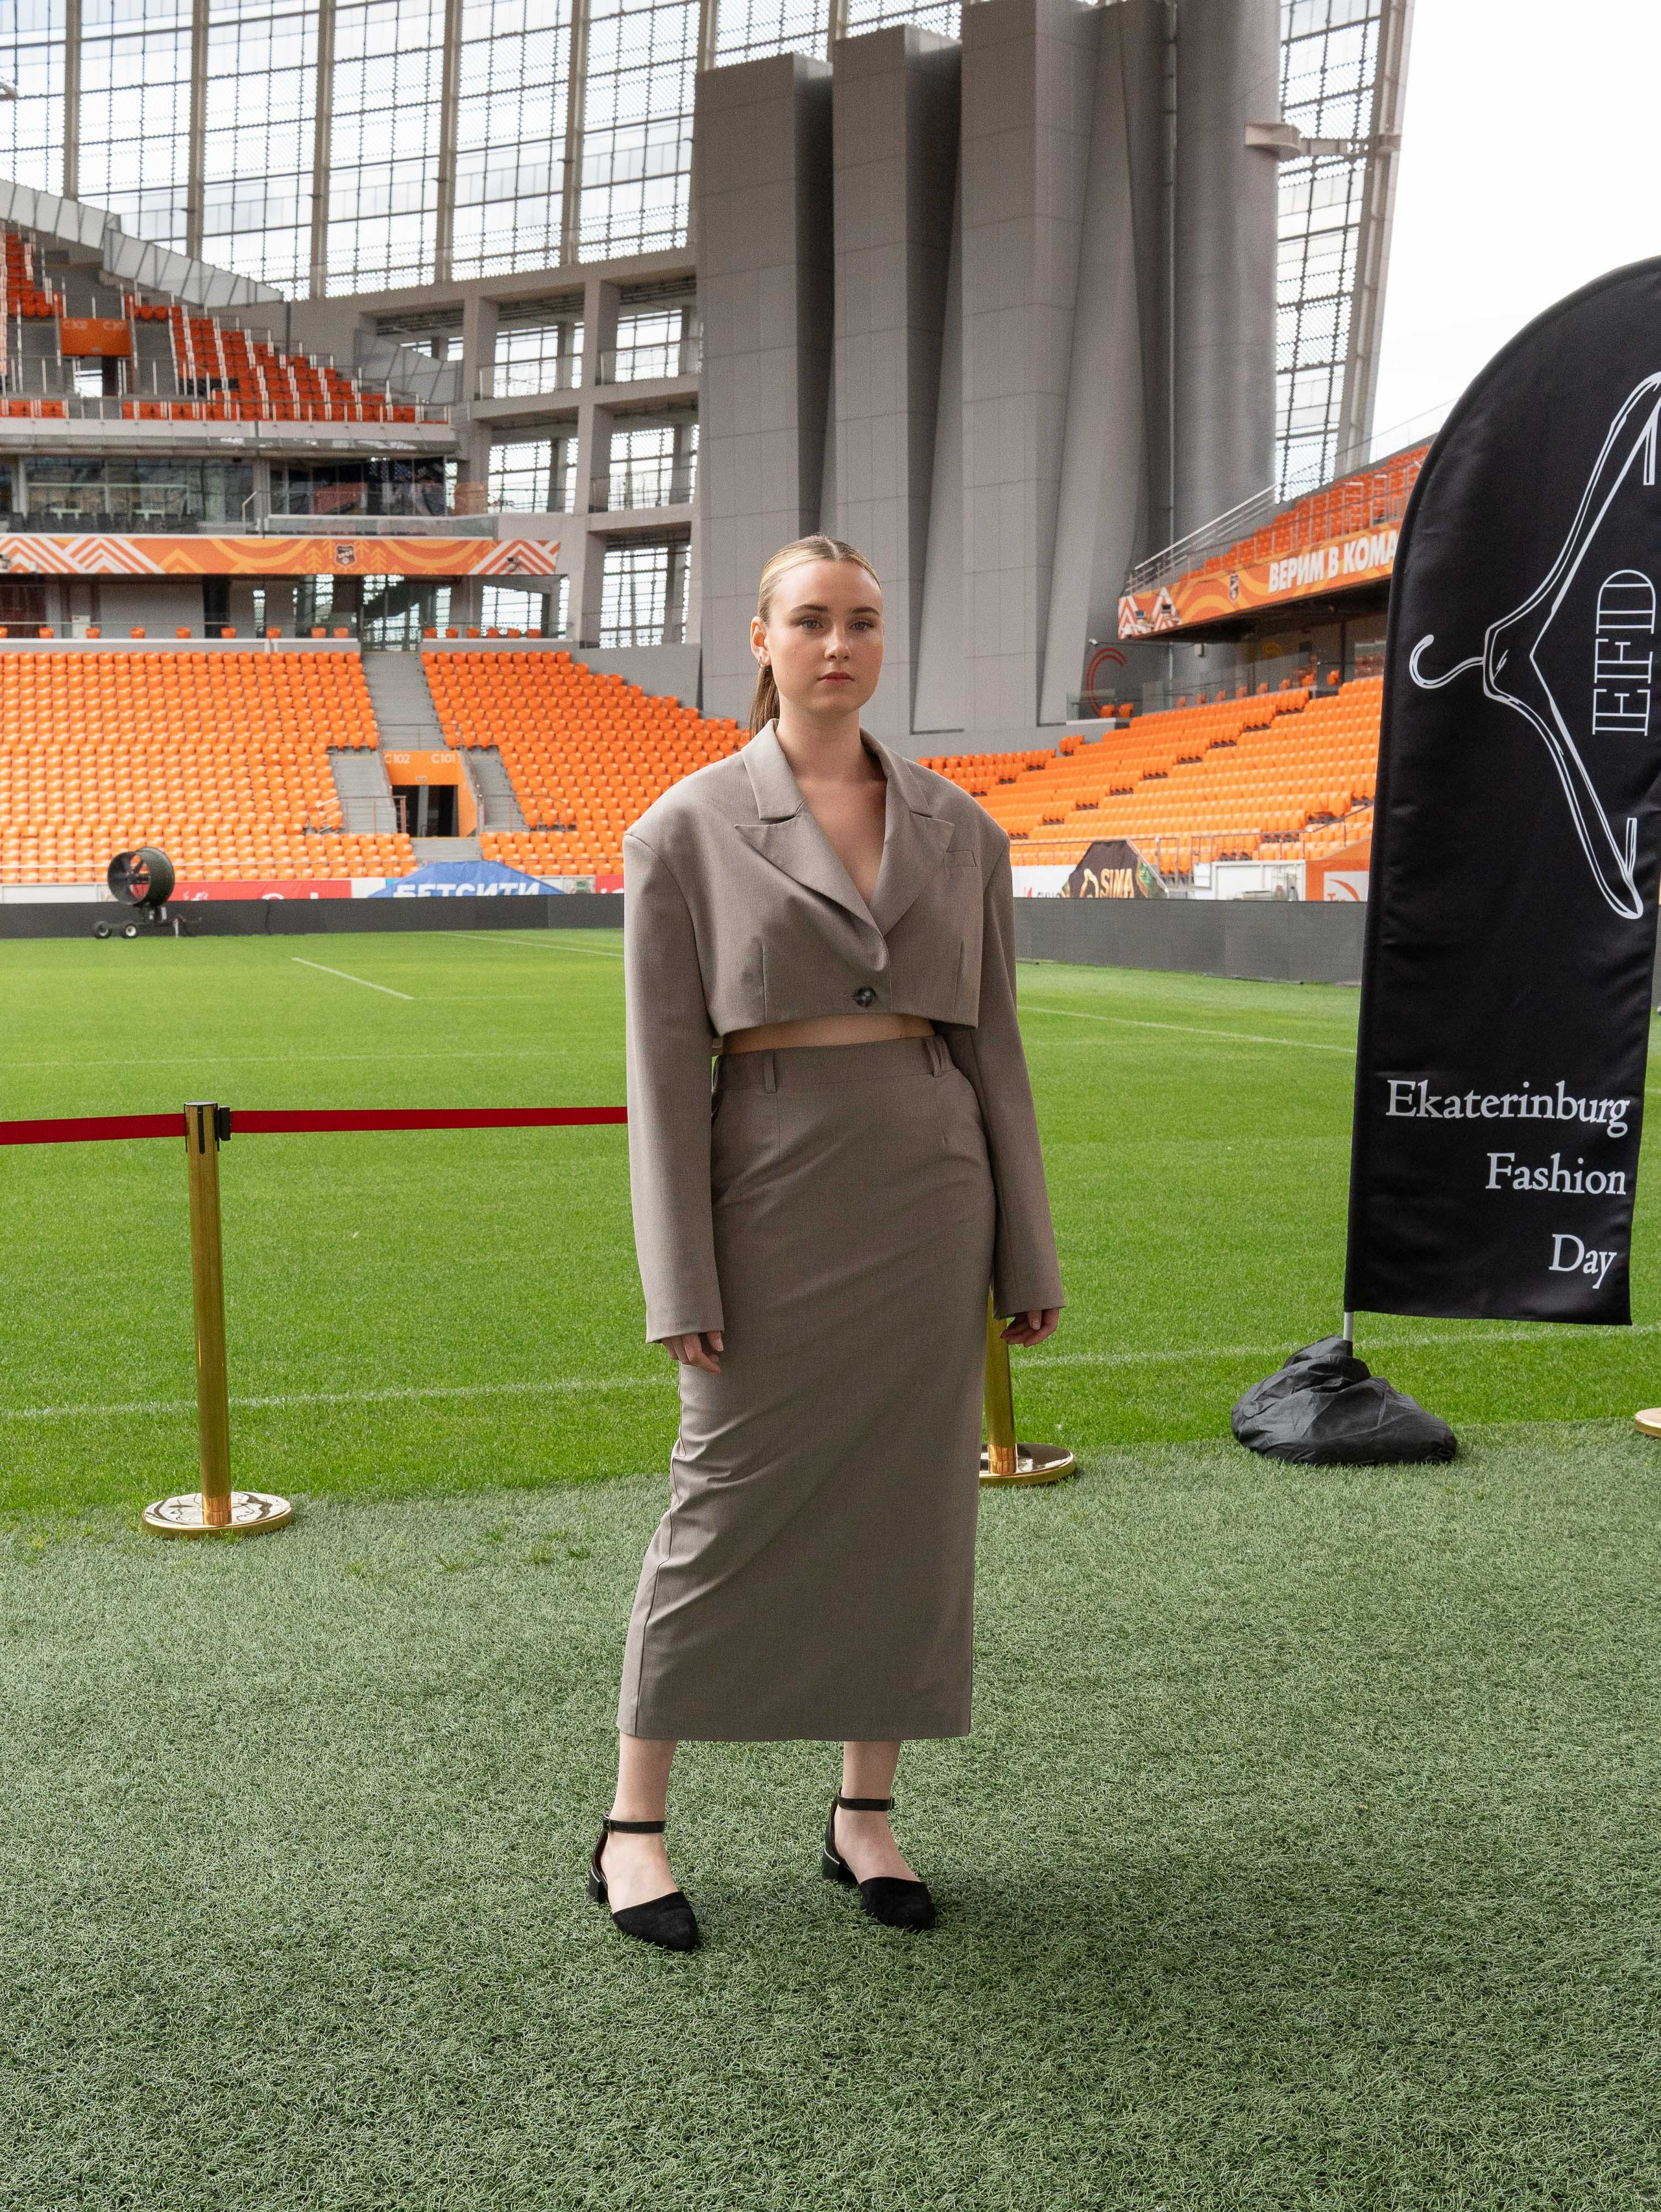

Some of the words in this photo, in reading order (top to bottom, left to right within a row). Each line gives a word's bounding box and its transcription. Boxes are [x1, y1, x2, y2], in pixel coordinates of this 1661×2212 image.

[1268, 549, 1325, 594] ВЕРИМ
[1328, 546, 1340, 579] В
[1592, 569, 1656, 736] EFD
[1100, 868, 1135, 898] SIMA
[1385, 1079, 1631, 1138] Ekaterinburg
[1485, 1152, 1627, 1196] Fashion
[1548, 1233, 1618, 1290] Day
